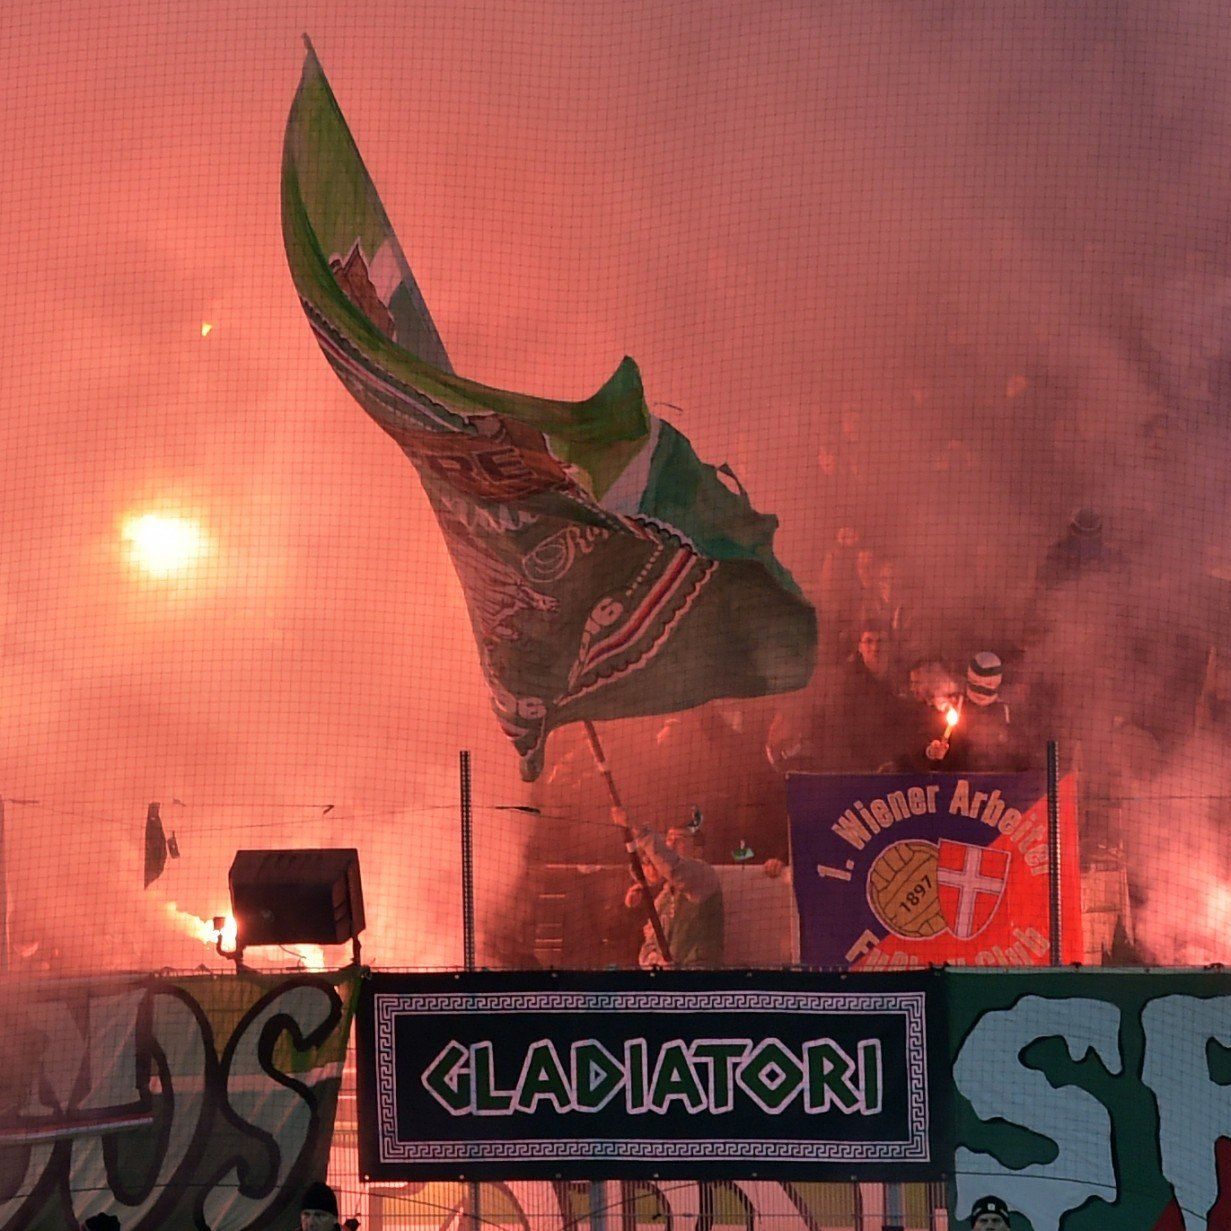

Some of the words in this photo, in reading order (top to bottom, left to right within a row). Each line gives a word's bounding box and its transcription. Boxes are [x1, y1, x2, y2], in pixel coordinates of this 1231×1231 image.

[831, 784, 940, 851] Wiener
[817, 859, 855, 882] 1.
[899, 874, 933, 914] 1897
[421, 1038, 883, 1116] GLADIATORI
